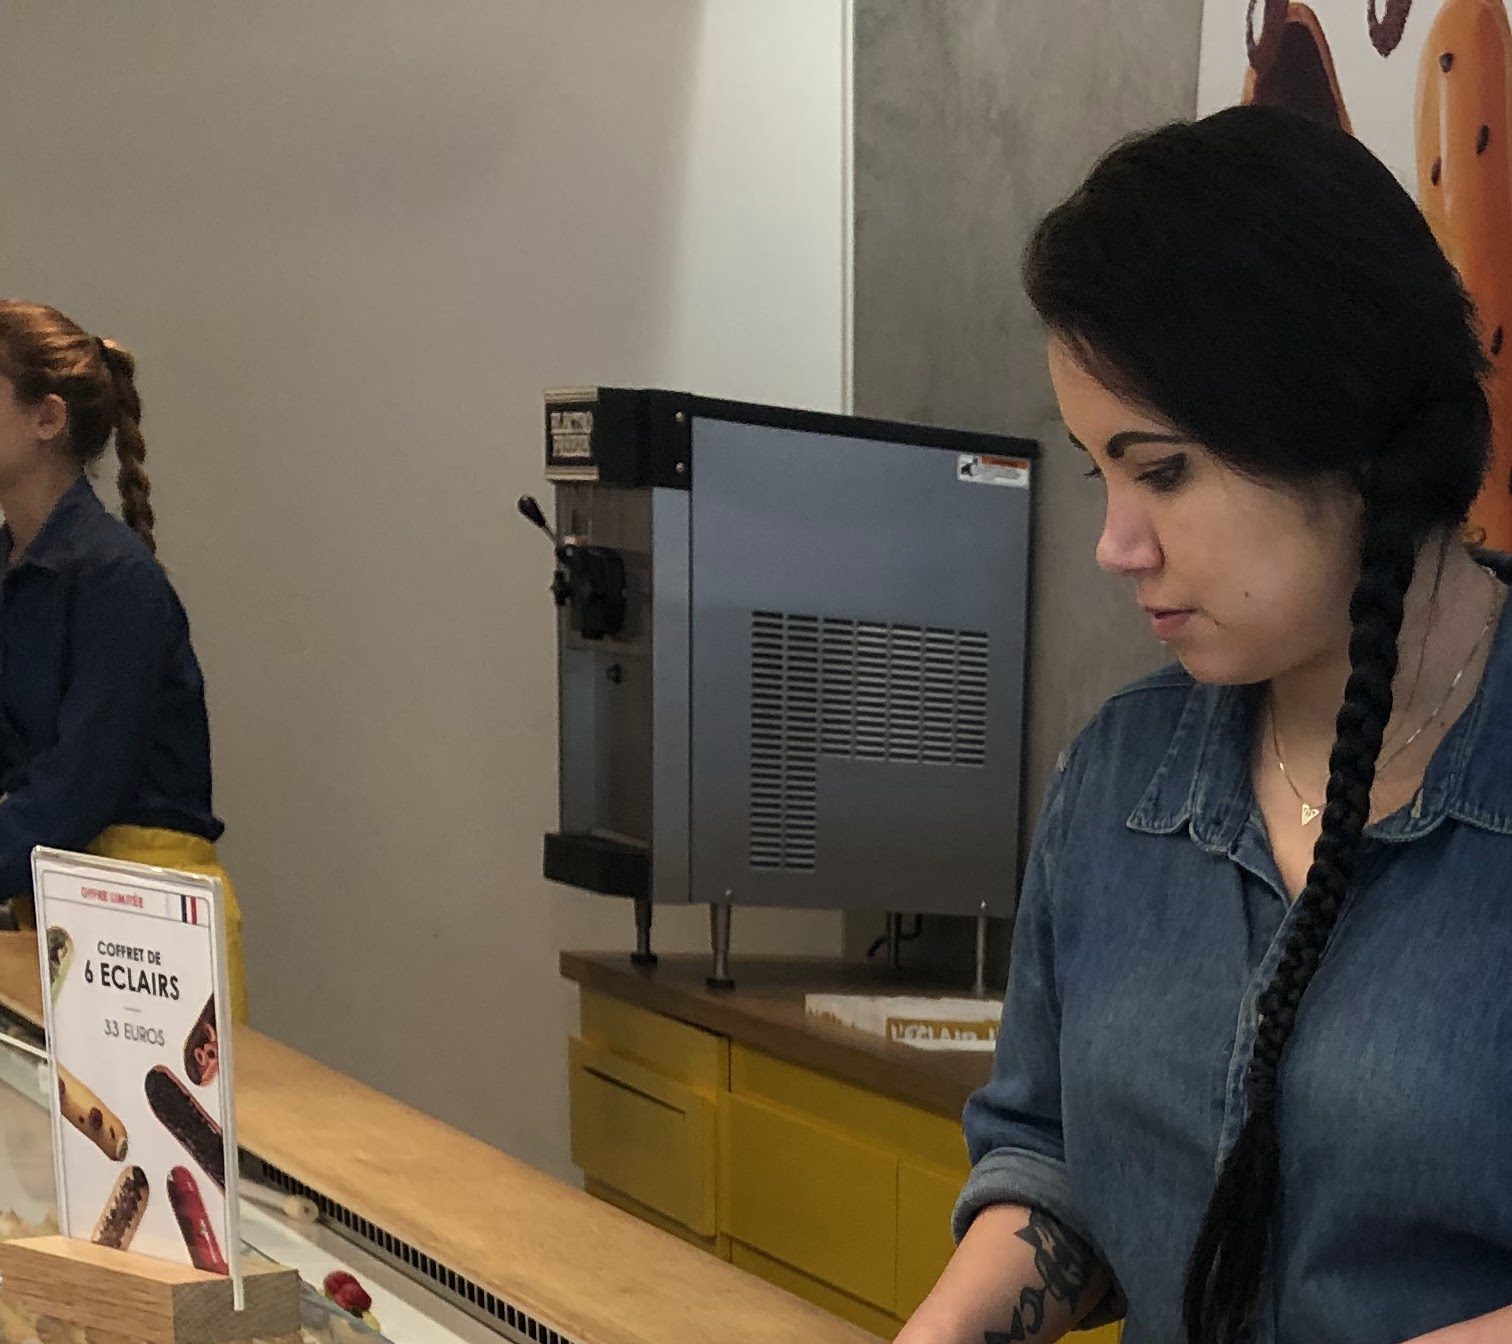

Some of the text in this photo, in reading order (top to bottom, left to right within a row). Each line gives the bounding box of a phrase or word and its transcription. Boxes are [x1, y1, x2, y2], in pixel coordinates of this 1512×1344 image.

[97, 940, 162, 966] COFFRET DE
[84, 959, 180, 1001] 6 ECLAIRS
[104, 1018, 166, 1047] 33 EUROS
